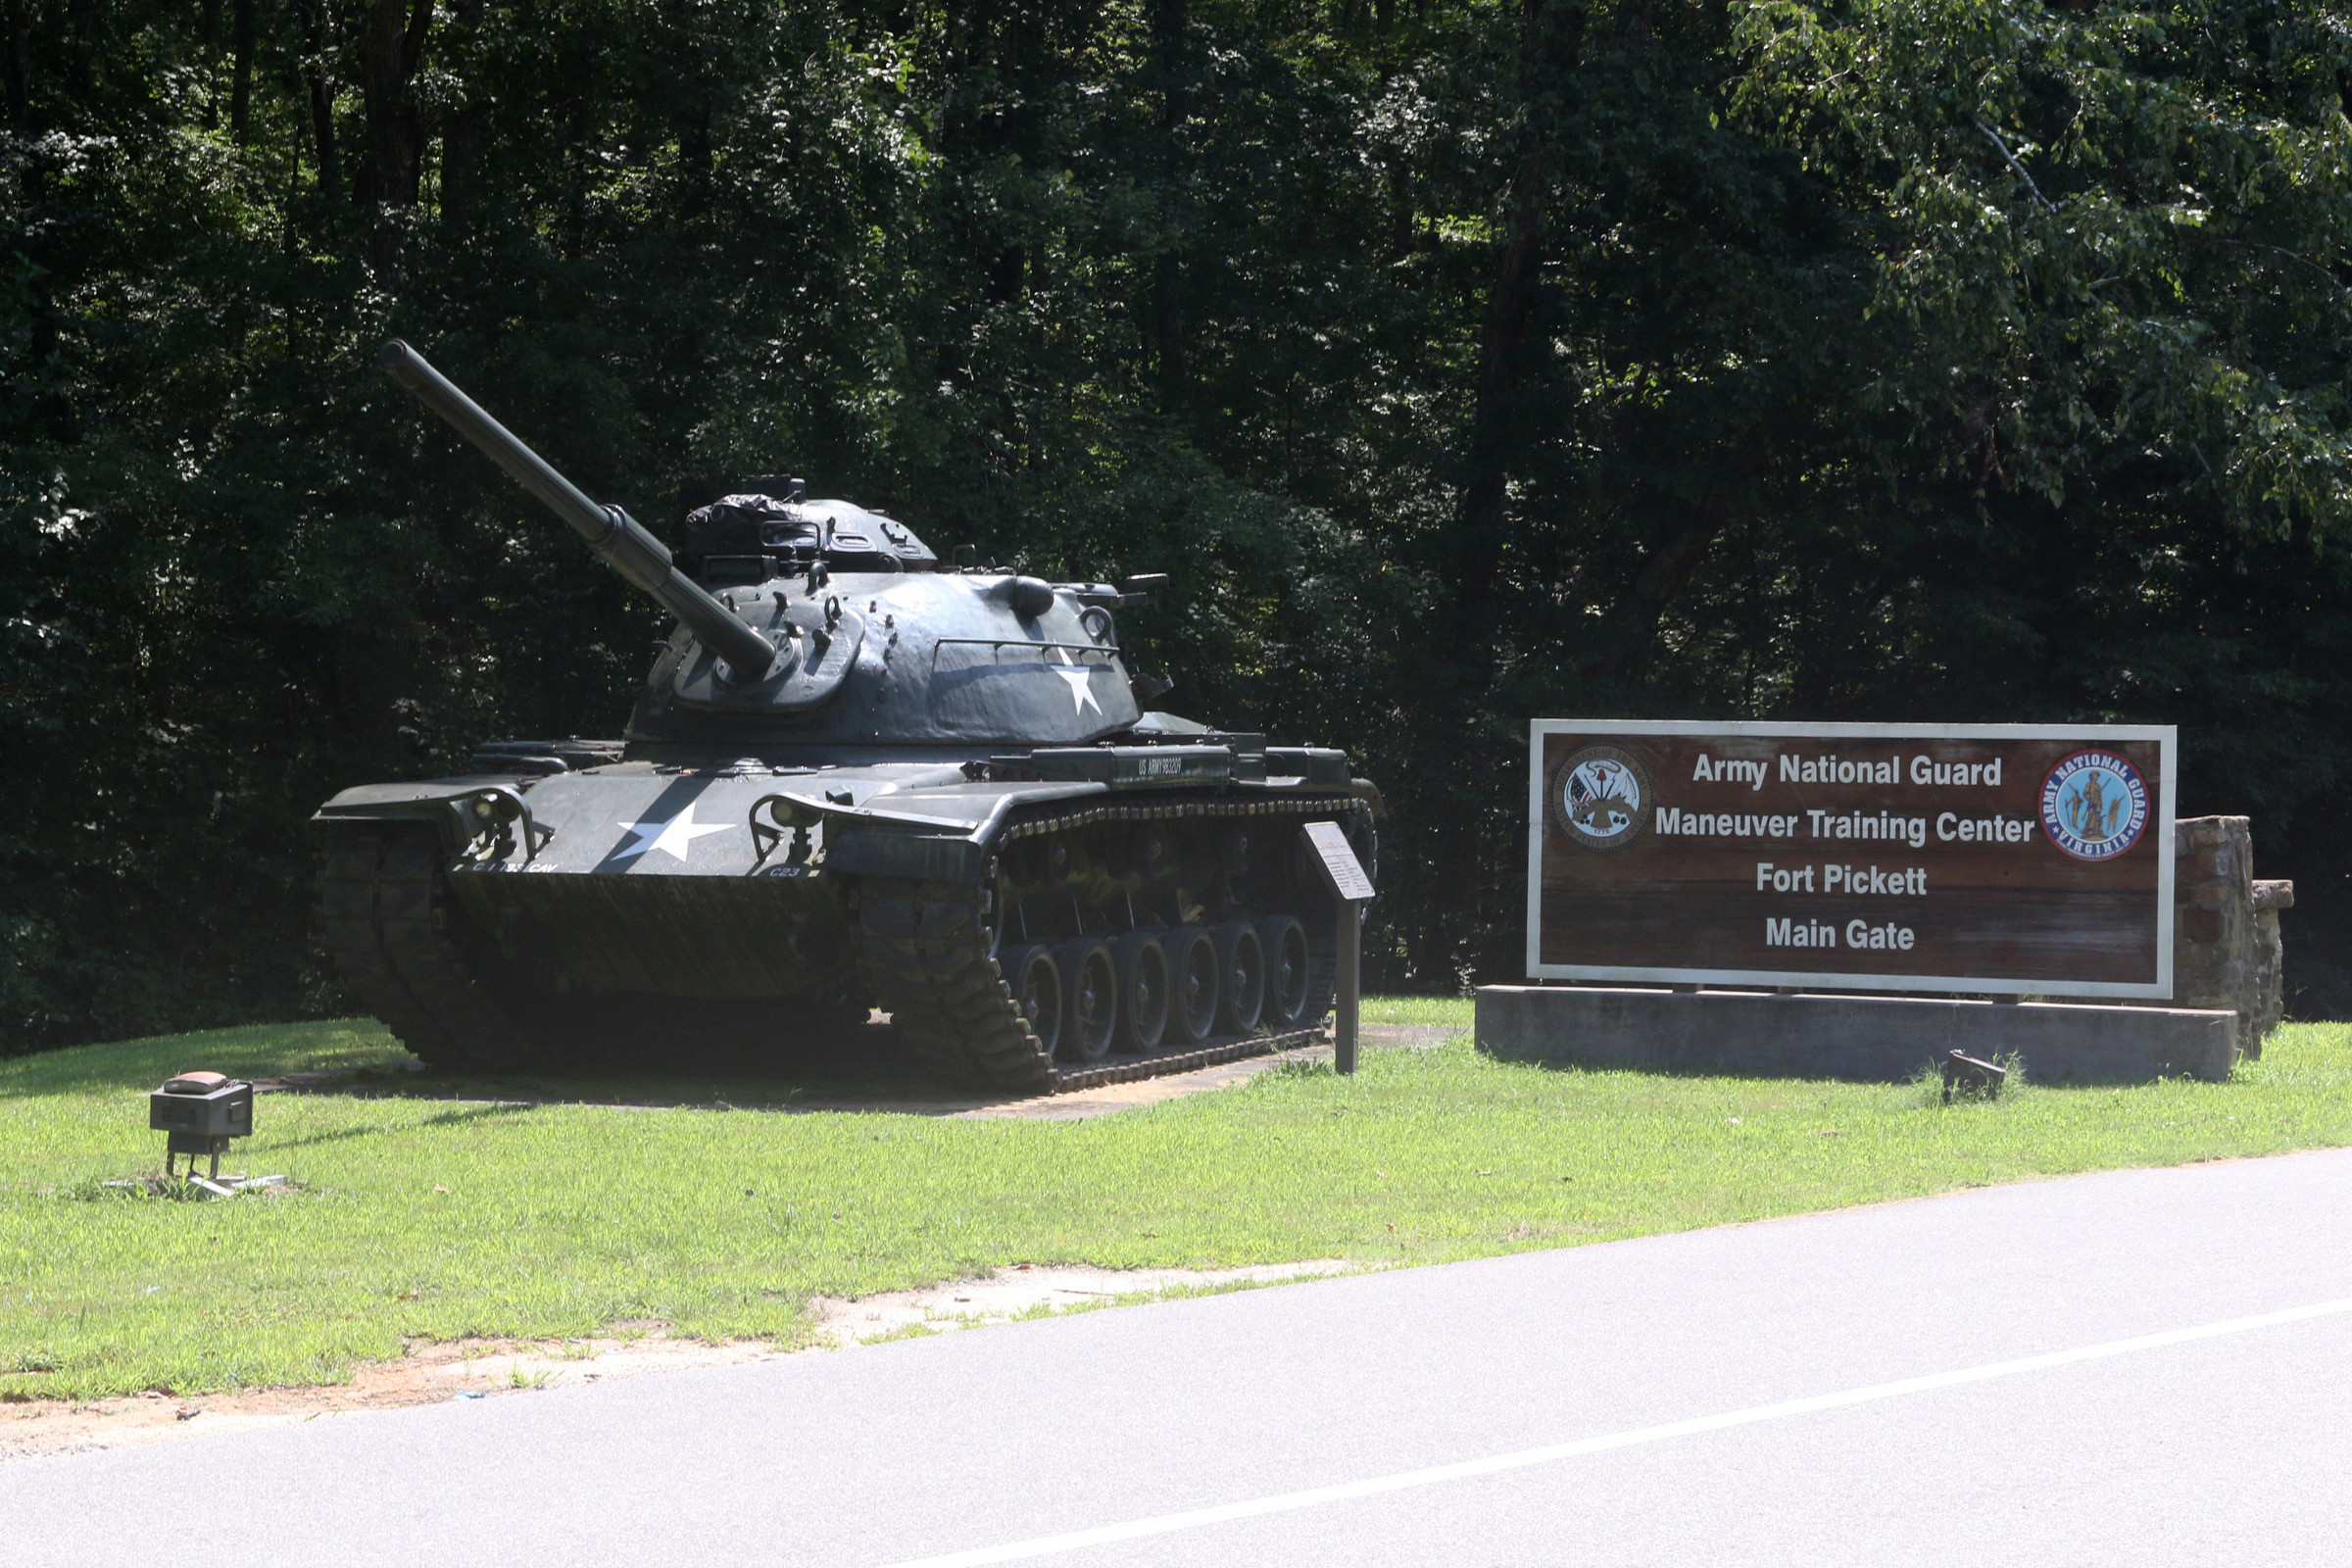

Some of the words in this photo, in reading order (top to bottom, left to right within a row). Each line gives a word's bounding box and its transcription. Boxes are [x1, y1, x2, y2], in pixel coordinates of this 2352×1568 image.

[1138, 759, 1147, 775] US
[1692, 754, 1768, 791] Army
[1780, 754, 1900, 785] National
[1910, 755, 2001, 787] Guard
[2042, 780, 2059, 824] ARMY
[2054, 753, 2130, 781] NATIONAL
[2127, 777, 2146, 831] GUARD
[1655, 807, 1798, 838] Maneuver
[1807, 809, 1926, 848] Training
[1936, 811, 2034, 843] Center
[2058, 830, 2130, 855] VIRGINIA
[472, 862, 485, 871] C
[529, 863, 559, 872] CAV
[769, 867, 800, 876] C23
[1756, 862, 1815, 893] Fort
[1824, 863, 1928, 896] Pickett
[1766, 917, 1837, 949] Main
[1845, 918, 1915, 951] Gate
